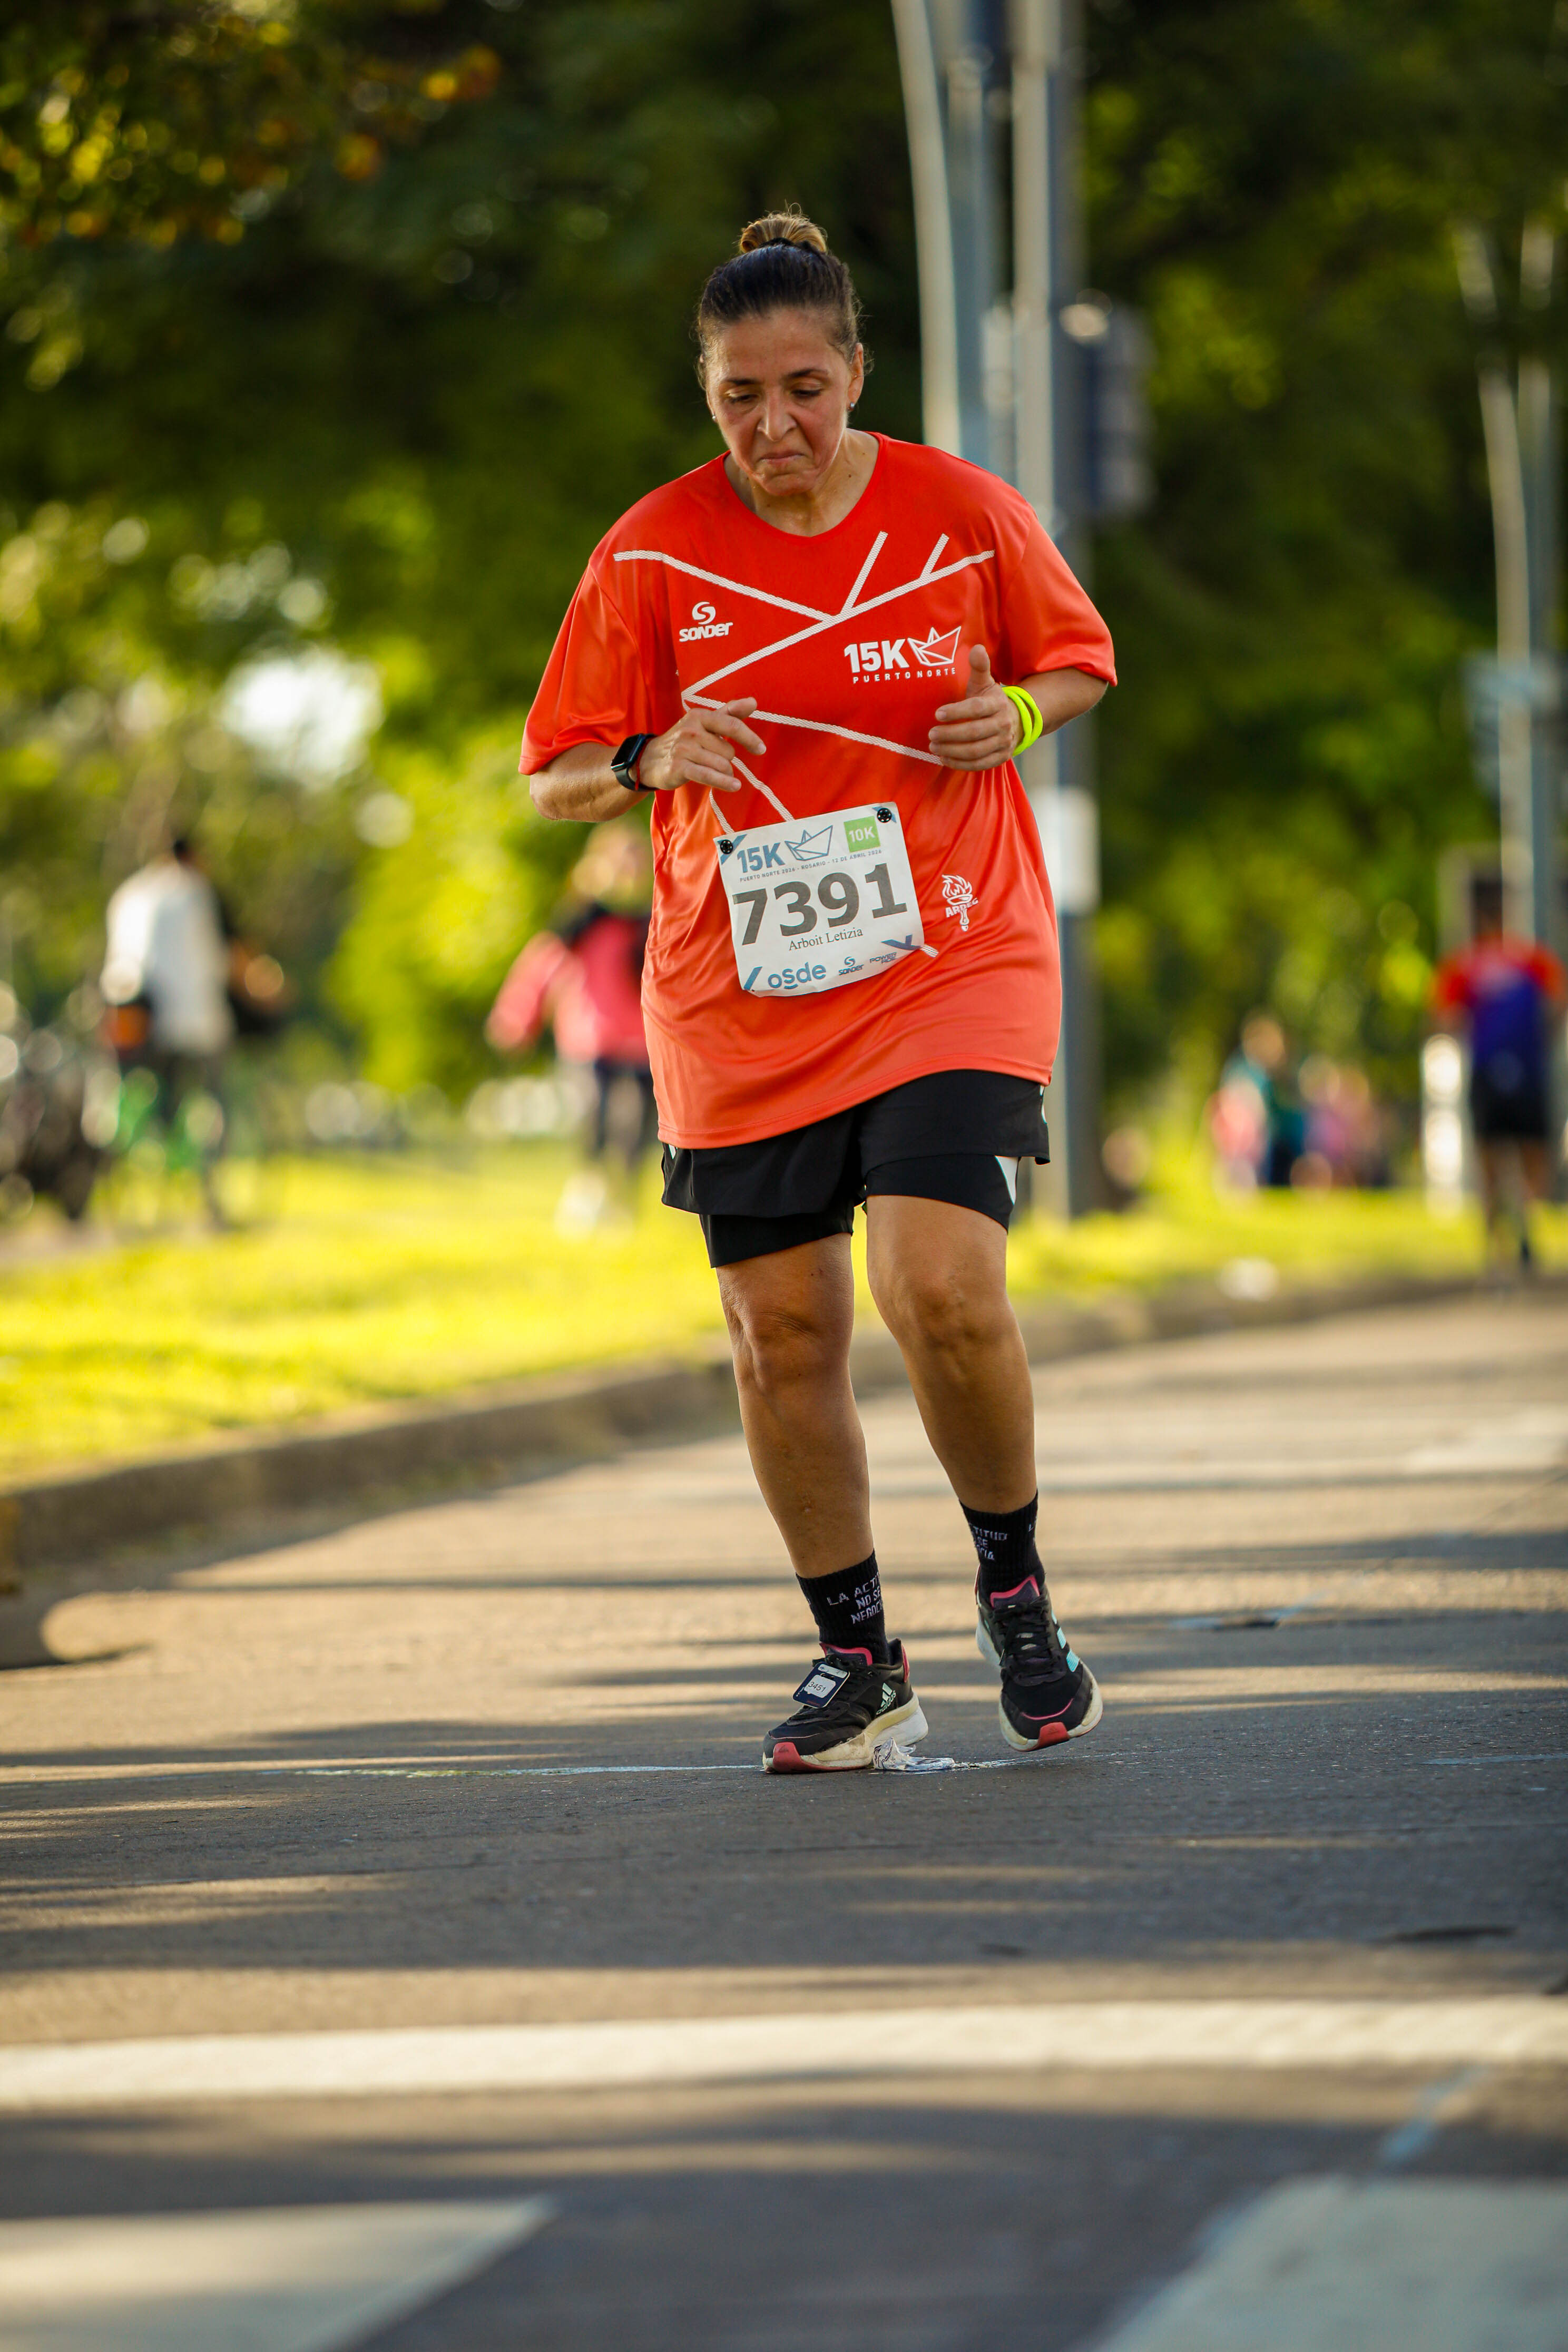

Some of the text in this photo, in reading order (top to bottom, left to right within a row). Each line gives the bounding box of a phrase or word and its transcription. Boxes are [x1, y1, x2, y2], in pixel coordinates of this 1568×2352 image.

[844, 639, 909, 673] 15K
[853, 667, 956, 684] PUERTO NORTE
[849, 826, 875, 842] 10K
[737, 842, 786, 873] 15K
[740, 874, 760, 883] PUERTO
[801, 861, 826, 869] ROSARIO
[732, 863, 907, 946] 7391
[789, 927, 864, 951] Arboit Letizia
[869, 951, 897, 964] POWER
[768, 962, 827, 989] osde
[827, 1592, 850, 1606] LA
[855, 1594, 872, 1610] NO
[808, 1681, 827, 1692] 3451
[876, 1690, 896, 1715] adidas
